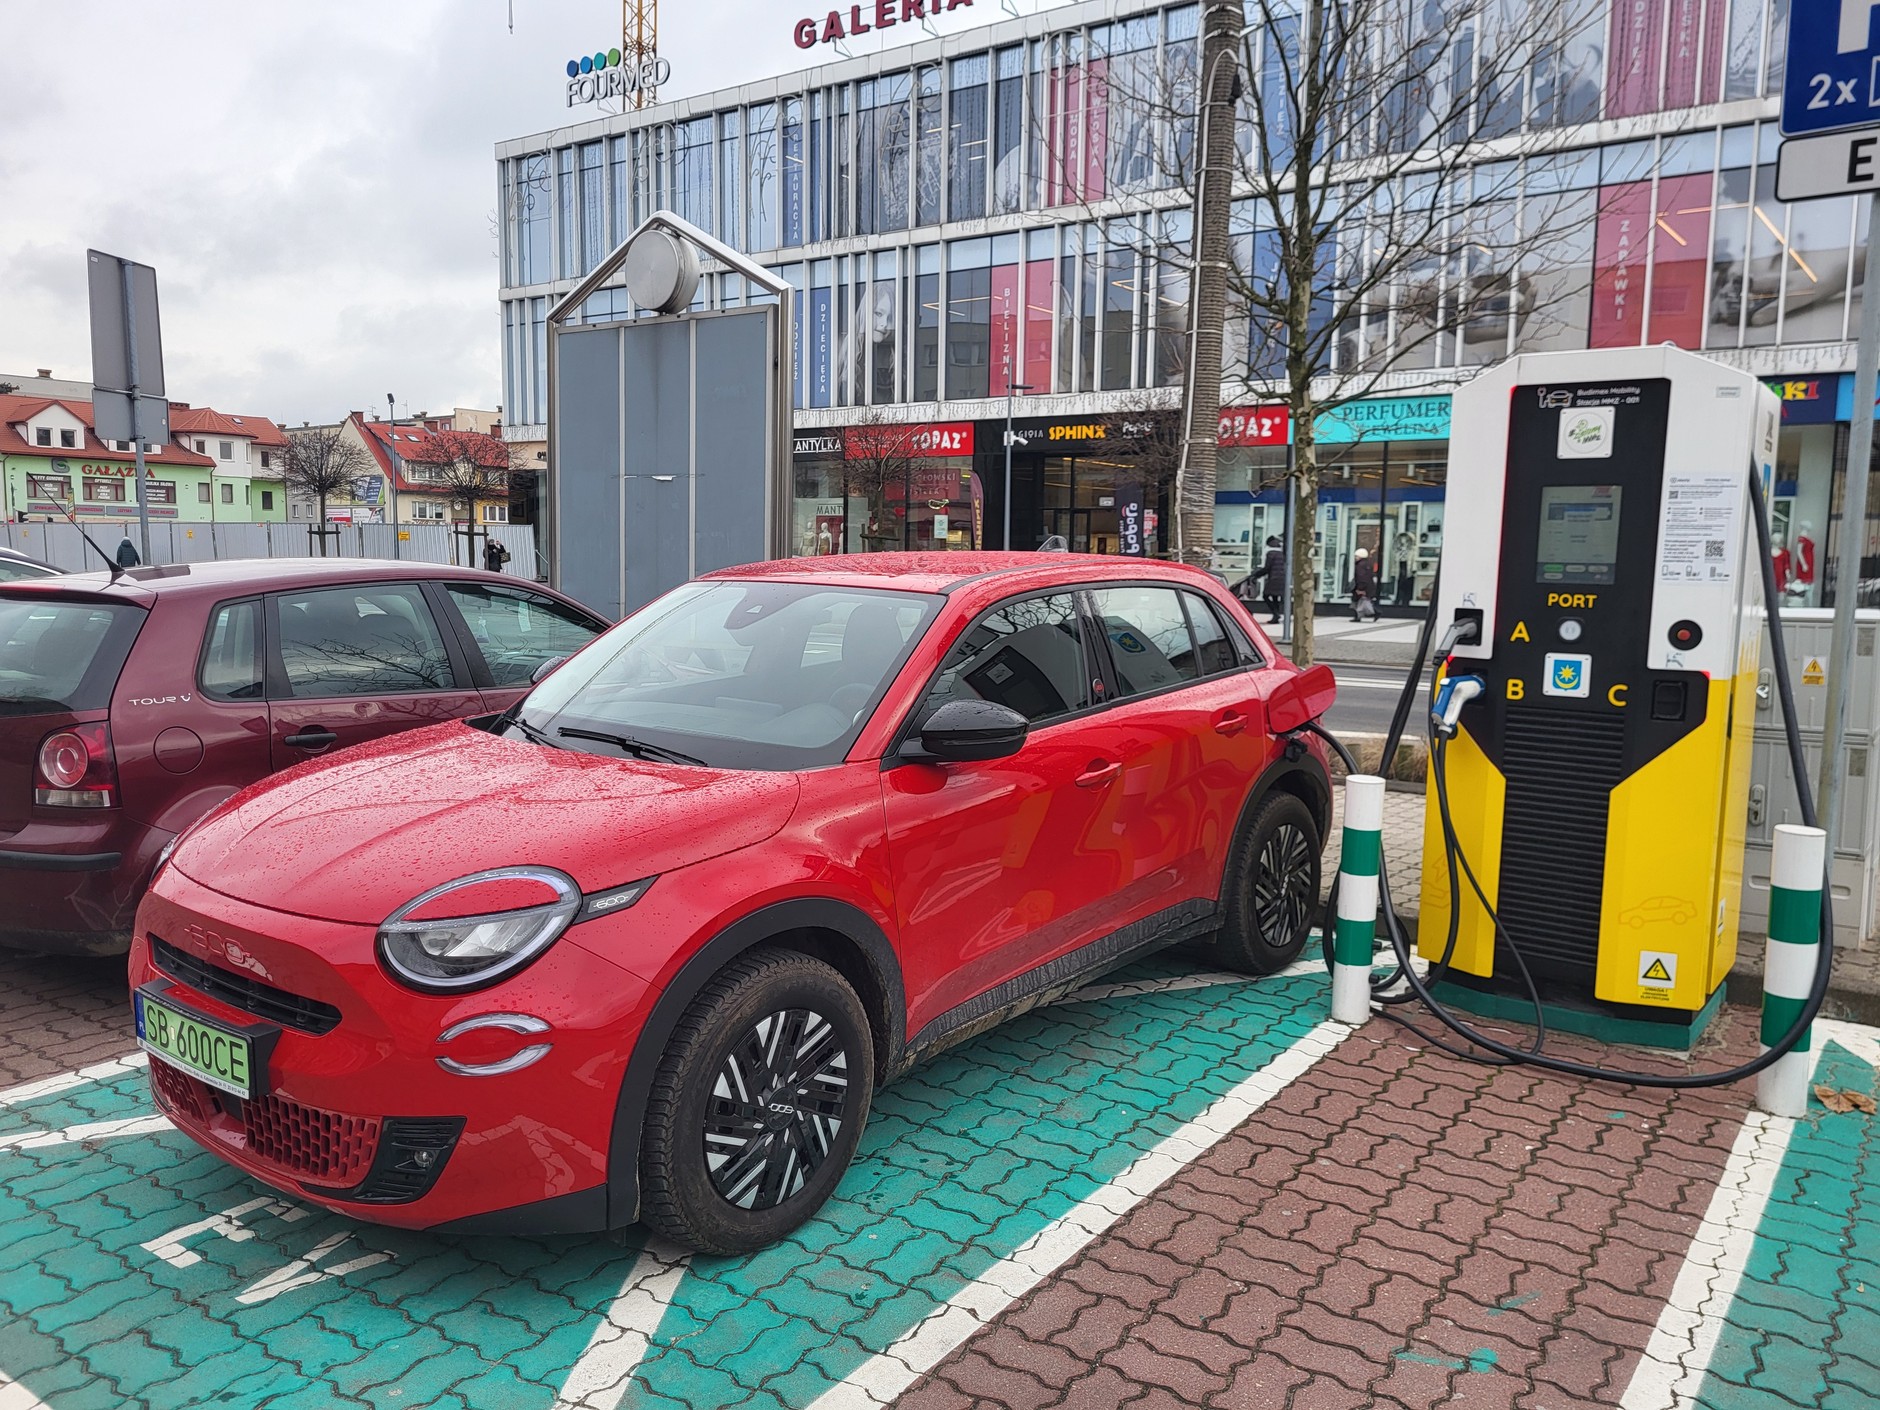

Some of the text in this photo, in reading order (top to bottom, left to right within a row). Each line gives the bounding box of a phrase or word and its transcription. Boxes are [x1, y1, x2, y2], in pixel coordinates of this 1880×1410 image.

[1630, 0, 1646, 75] DZIEŻ
[566, 57, 671, 107] FOURMED
[1806, 73, 1858, 110] 2x
[1070, 114, 1078, 160] MODA
[1847, 136, 1878, 184] E
[1002, 287, 1011, 376] BIELIZNA
[819, 303, 827, 393] DZIECIĘCA
[1343, 402, 1450, 422] PERFUMER
[1048, 425, 1107, 440] SPHINX
[1217, 416, 1273, 439] OPAZ
[795, 436, 843, 453] ANTYLKA
[911, 430, 962, 450] TOPAZ
[1547, 592, 1598, 609] PORT
[1509, 620, 1531, 642] A
[1506, 678, 1525, 700] B
[1607, 683, 1629, 707] C
[128, 696, 177, 706] TOUR
[593, 894, 630, 909] 600
[147, 1004, 170, 1049] SB
[177, 1021, 245, 1084] 600CE
